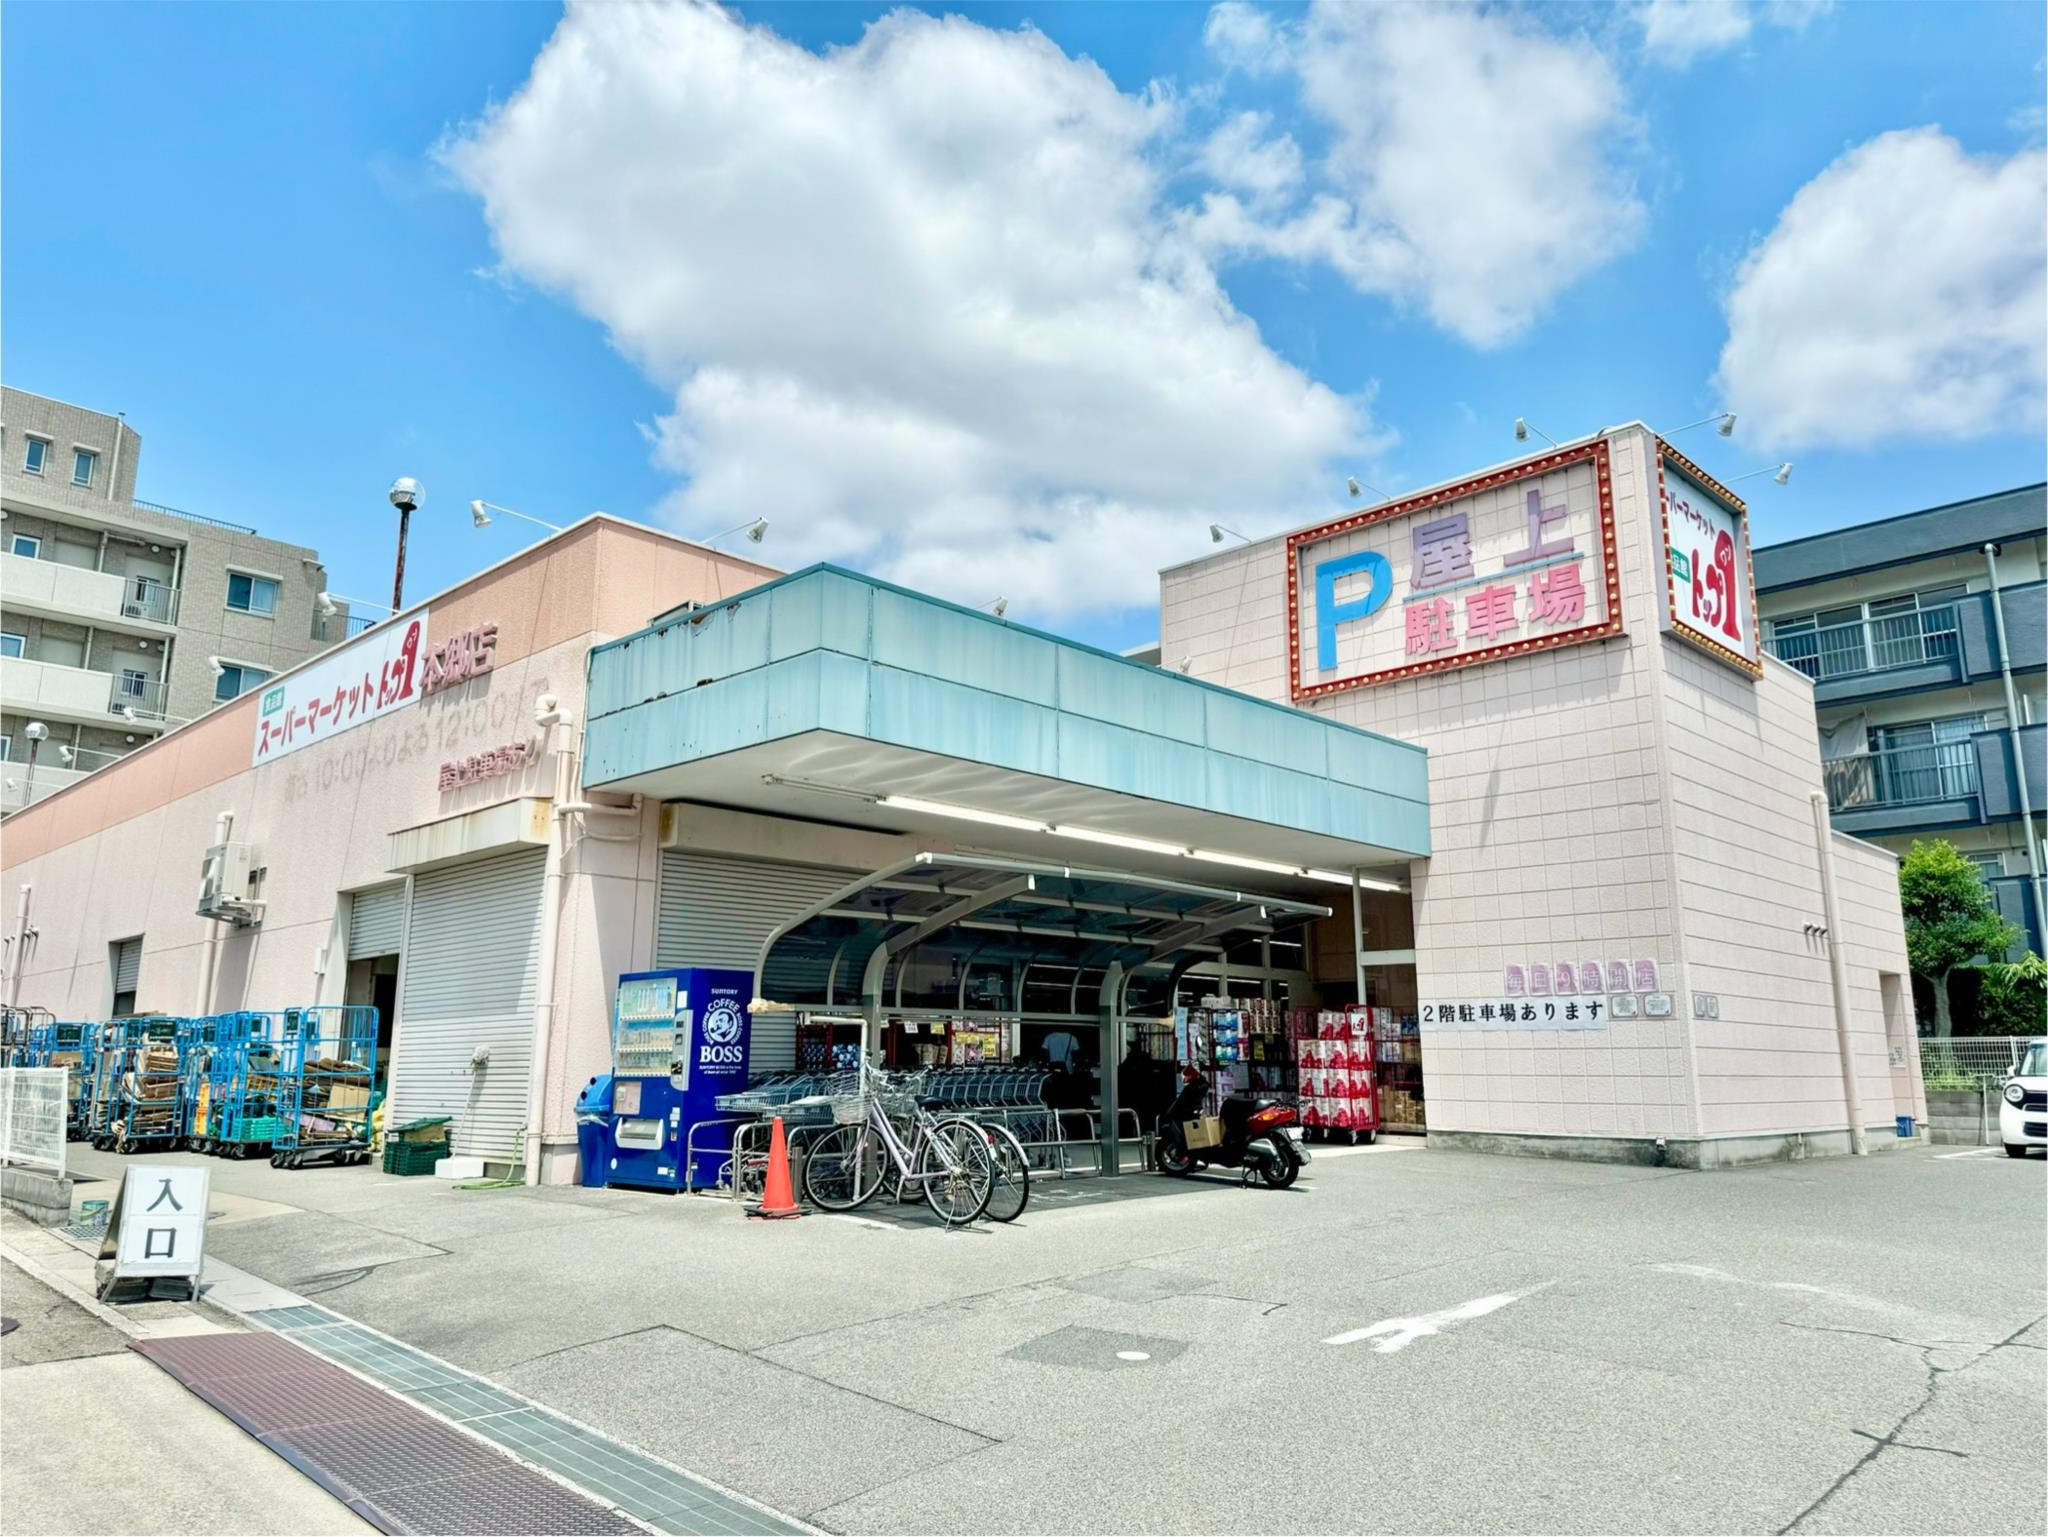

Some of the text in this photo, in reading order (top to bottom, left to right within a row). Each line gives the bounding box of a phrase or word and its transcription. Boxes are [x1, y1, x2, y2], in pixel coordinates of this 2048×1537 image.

[1410, 489, 1575, 589] 屋上
[1666, 491, 1716, 541] パーマーケット
[1315, 551, 1394, 672] P
[1405, 563, 1585, 656] 駐車場
[419, 622, 498, 692] 本郷店
[258, 672, 374, 757] スーパーマーケット
[707, 998, 740, 1013] COFFEE
[1423, 1001, 1605, 1023] 2階駐車場あります
[699, 1046, 743, 1062] BOSS
[144, 1178, 183, 1259] 入口
